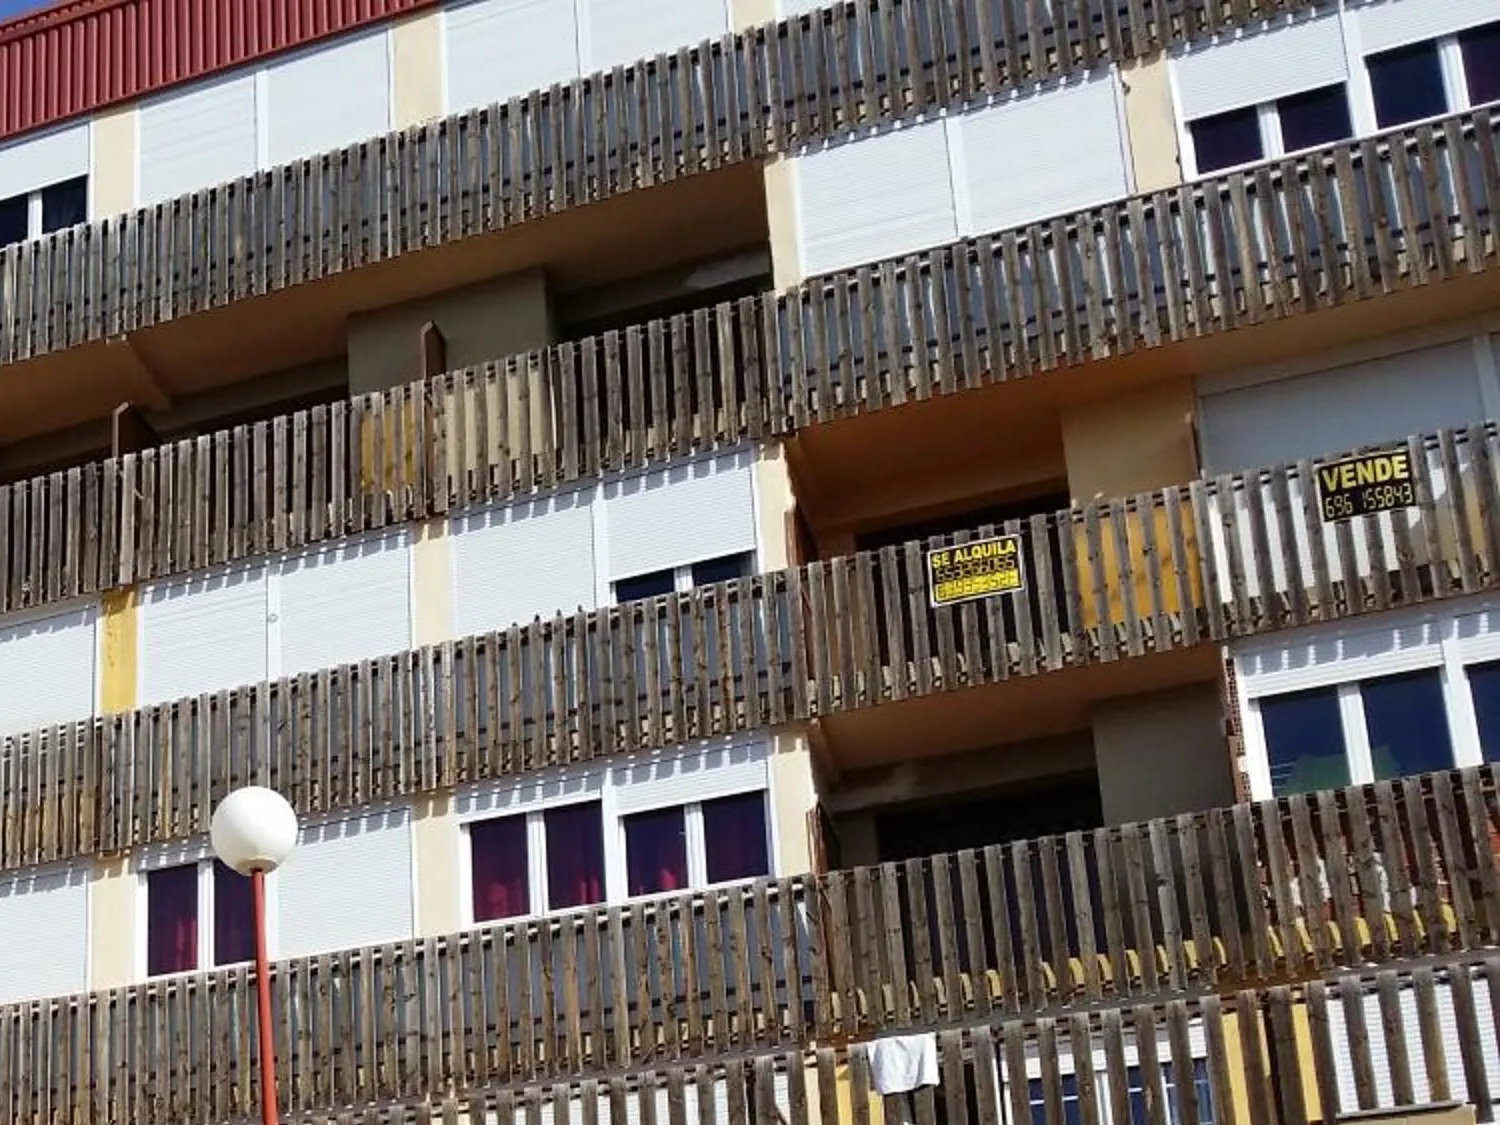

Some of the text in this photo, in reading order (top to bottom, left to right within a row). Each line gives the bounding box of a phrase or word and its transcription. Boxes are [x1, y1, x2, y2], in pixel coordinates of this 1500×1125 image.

[1322, 455, 1409, 492] VENDE
[1325, 493, 1353, 518] 696
[932, 540, 1016, 568] SE ALQUILA
